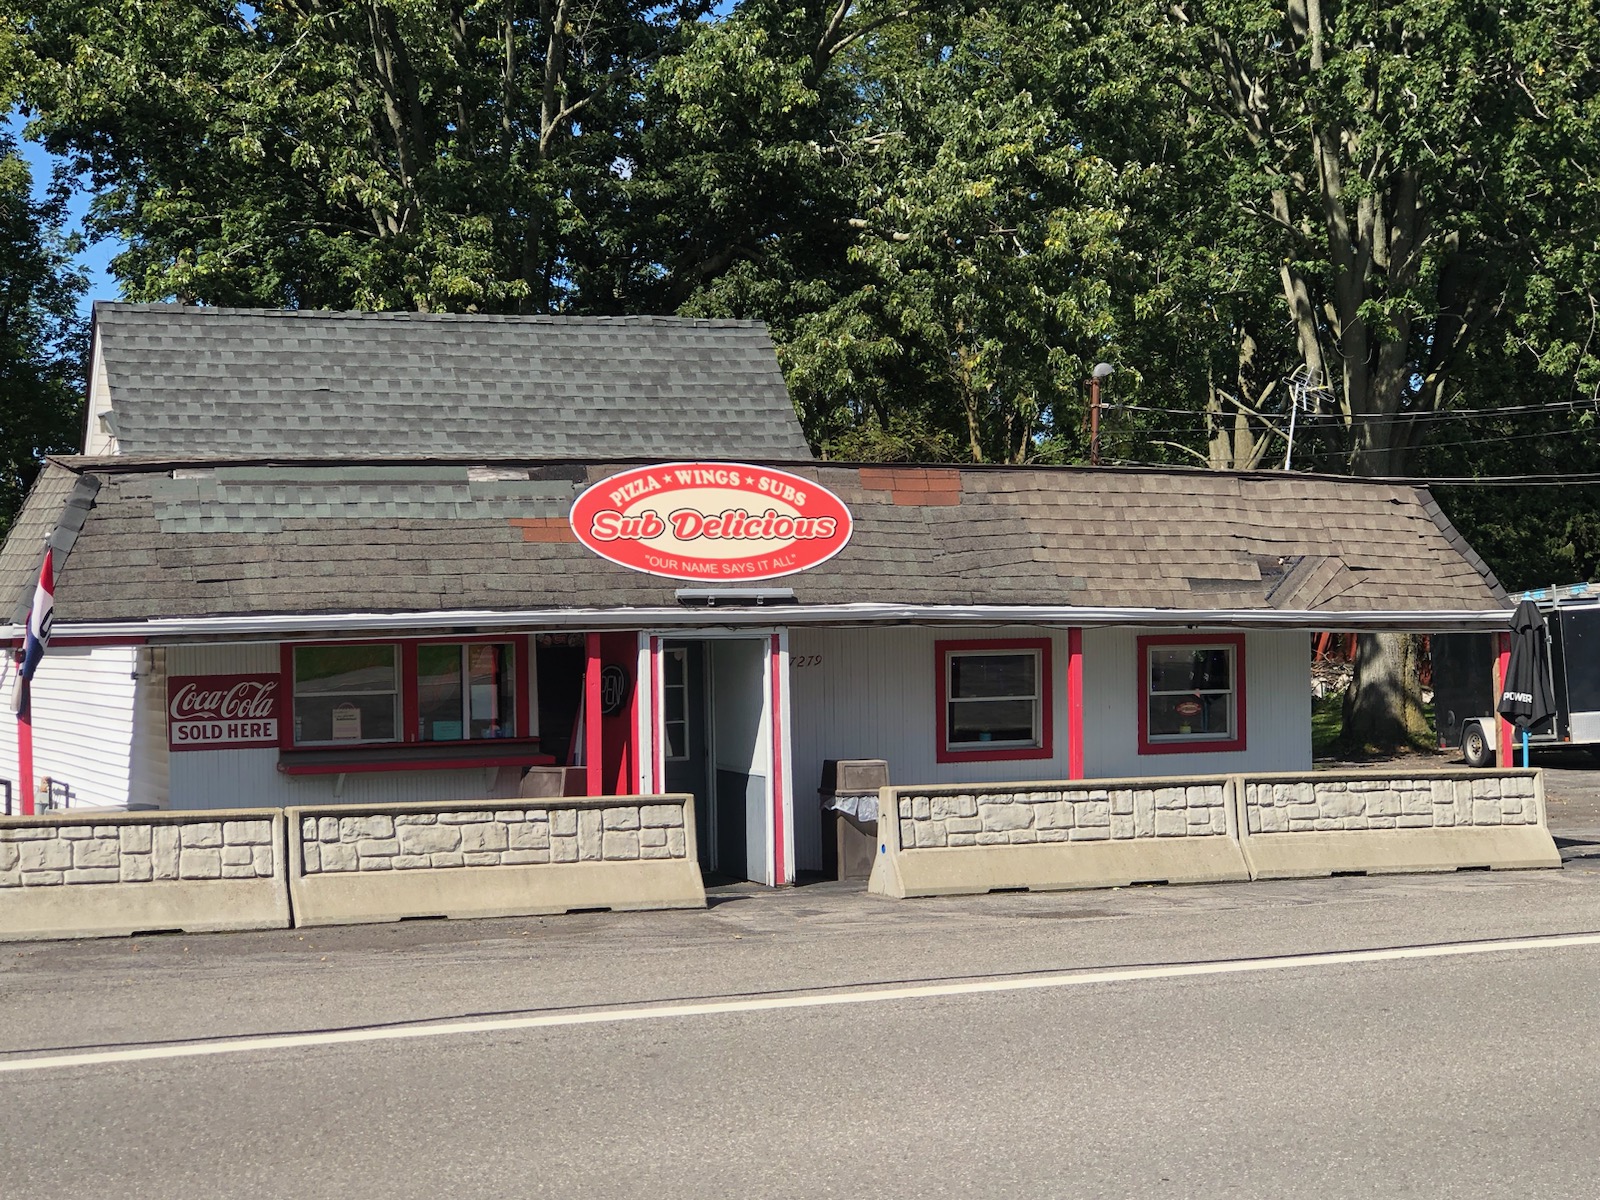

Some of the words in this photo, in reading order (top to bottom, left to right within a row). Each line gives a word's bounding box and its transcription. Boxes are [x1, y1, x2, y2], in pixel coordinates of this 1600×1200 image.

[609, 475, 662, 507] PIZZA
[674, 469, 740, 486] WINGS
[758, 476, 807, 507] SUBS
[591, 510, 665, 541] Sub
[668, 508, 838, 541] Delicious
[645, 554, 678, 569] "OUR
[682, 562, 719, 574] NAME
[722, 562, 755, 573] SAYS
[757, 560, 768, 571] IT
[773, 554, 796, 569] ALL"
[789, 654, 823, 668] 7279
[170, 681, 278, 719] Coca-Cola
[1503, 691, 1533, 703] POWER
[178, 725, 222, 740] SOLD
[227, 723, 272, 738] HERE
